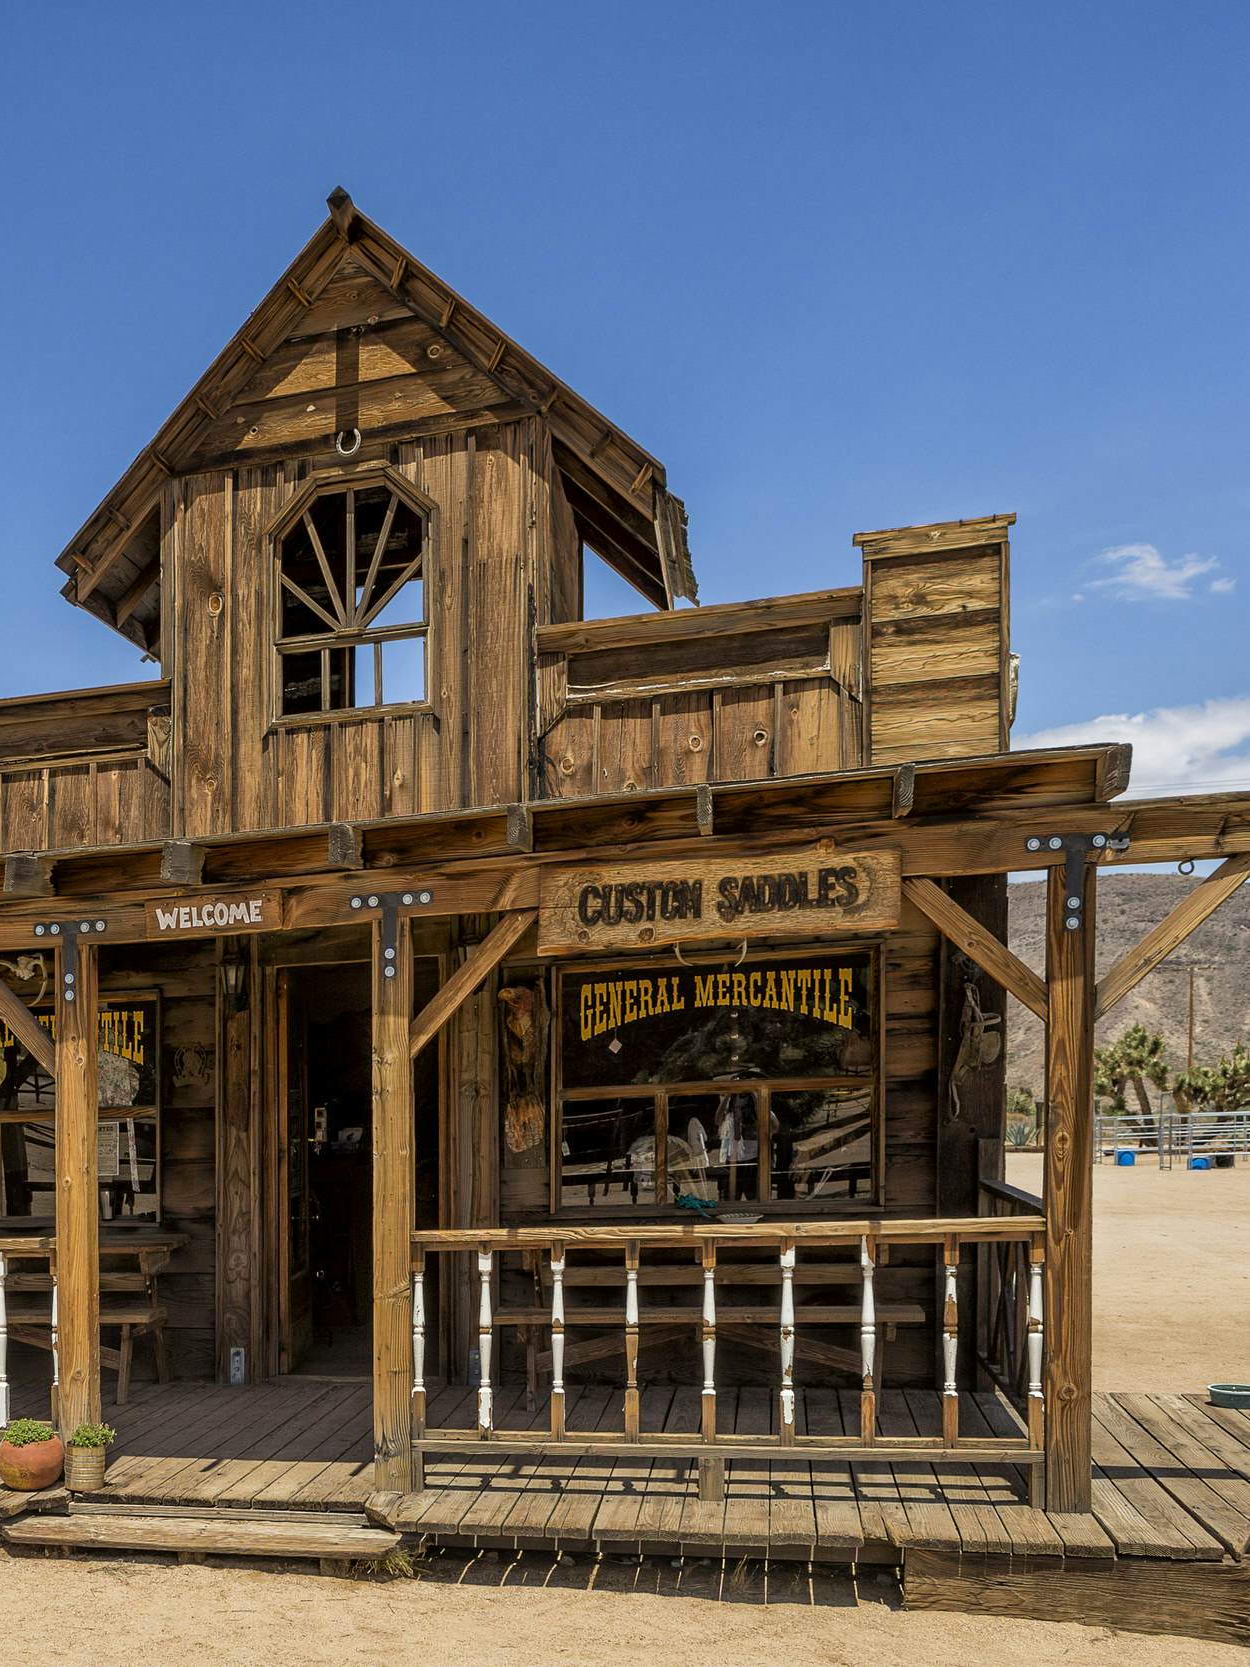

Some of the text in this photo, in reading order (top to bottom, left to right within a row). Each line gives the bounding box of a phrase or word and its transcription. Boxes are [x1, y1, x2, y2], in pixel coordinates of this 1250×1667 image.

[155, 900, 263, 930] WELCOME
[578, 866, 859, 927] CUSTOM SADDLES
[580, 967, 853, 1041] GENERAL MERCANTILE
